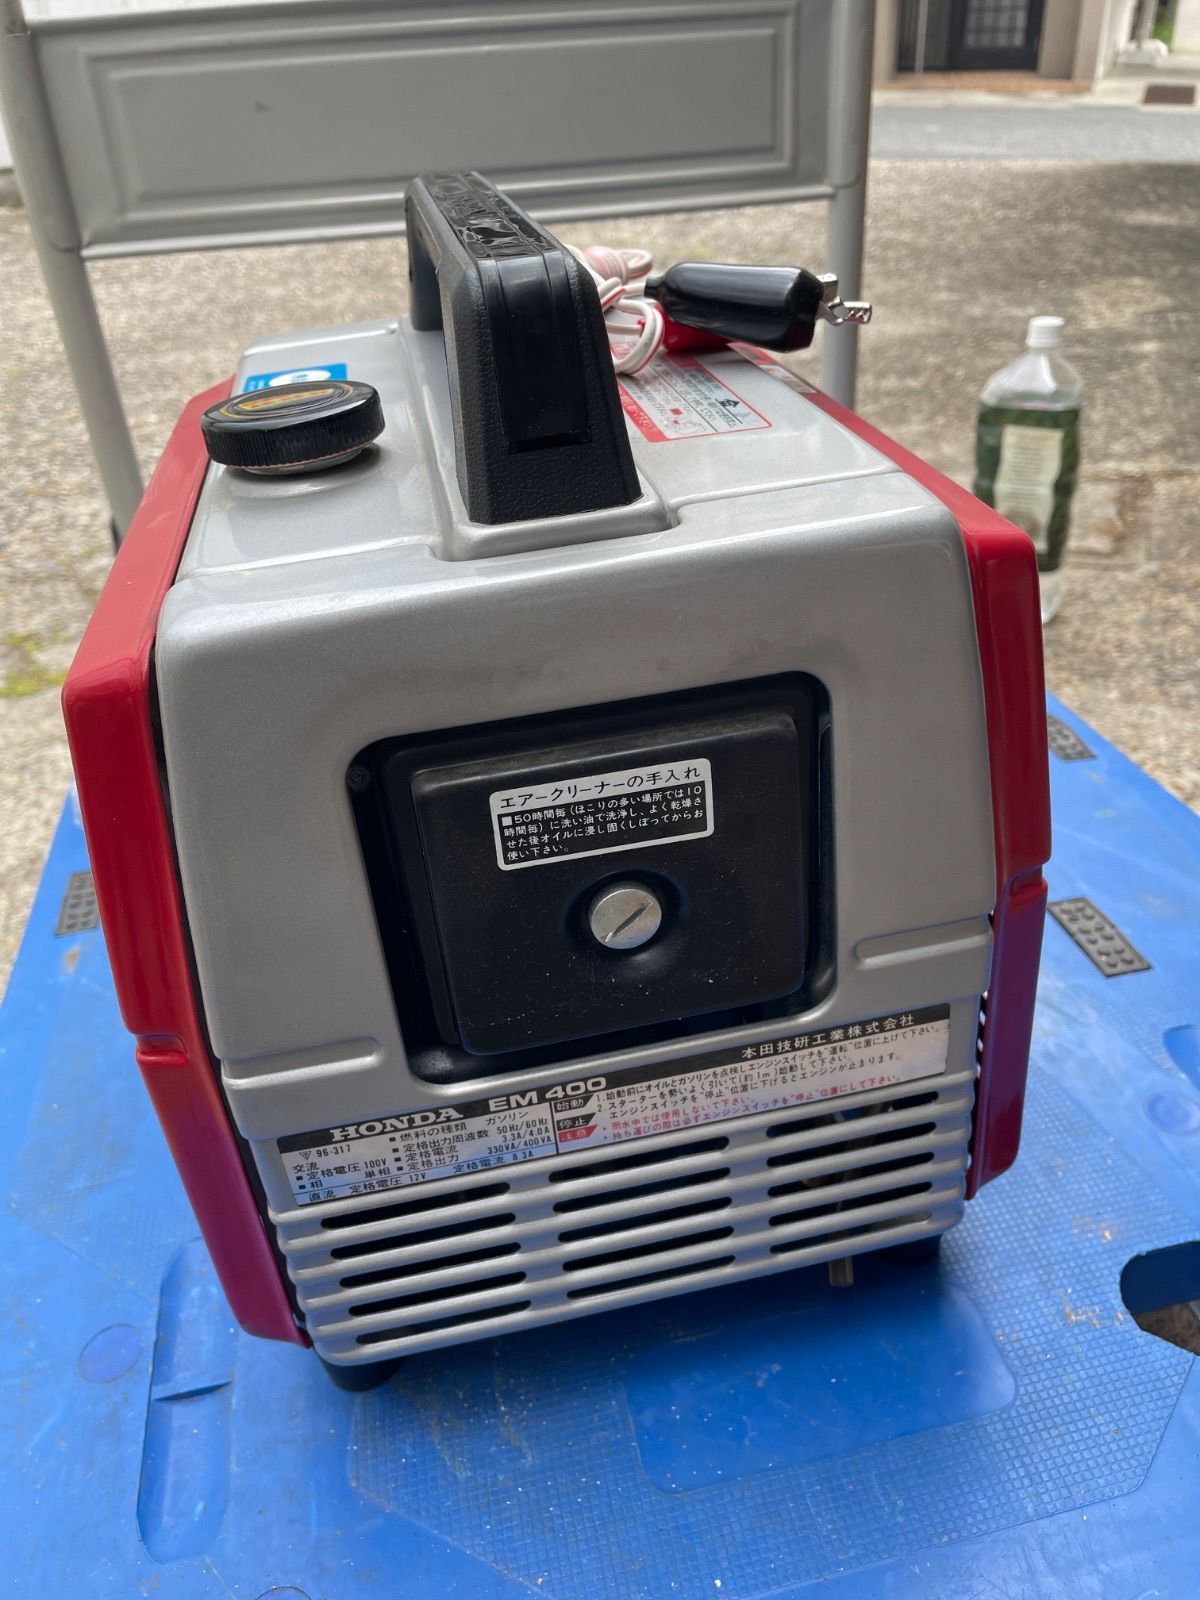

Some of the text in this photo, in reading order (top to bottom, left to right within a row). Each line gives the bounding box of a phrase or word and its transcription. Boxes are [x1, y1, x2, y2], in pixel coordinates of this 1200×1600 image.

[500, 767, 701, 808] エアークリーナーの手入れ
[506, 843, 570, 861] 使い下さい。
[741, 1013, 915, 1060] 本田技研工業株式会社
[488, 1076, 607, 1112] EM 400
[556, 1097, 585, 1111] 始動
[330, 1107, 464, 1142] HONDA
[400, 1111, 529, 1142] 燃料の種類 ガソリン
[558, 1116, 587, 1130] 停止
[402, 1129, 489, 1154] 定格出力周波数
[402, 1145, 459, 1163] 定格電流
[406, 1154, 459, 1172] 定格出力
[292, 1161, 320, 1174] 交流
[306, 1158, 387, 1181] 定格電圧 100V
[308, 1189, 337, 1202] 直流
[349, 1175, 403, 1195] 定格電圧
[409, 1172, 427, 1183] 12V
[453, 1157, 506, 1175] 定格電流
[309, 1166, 391, 1190] 相 単相
